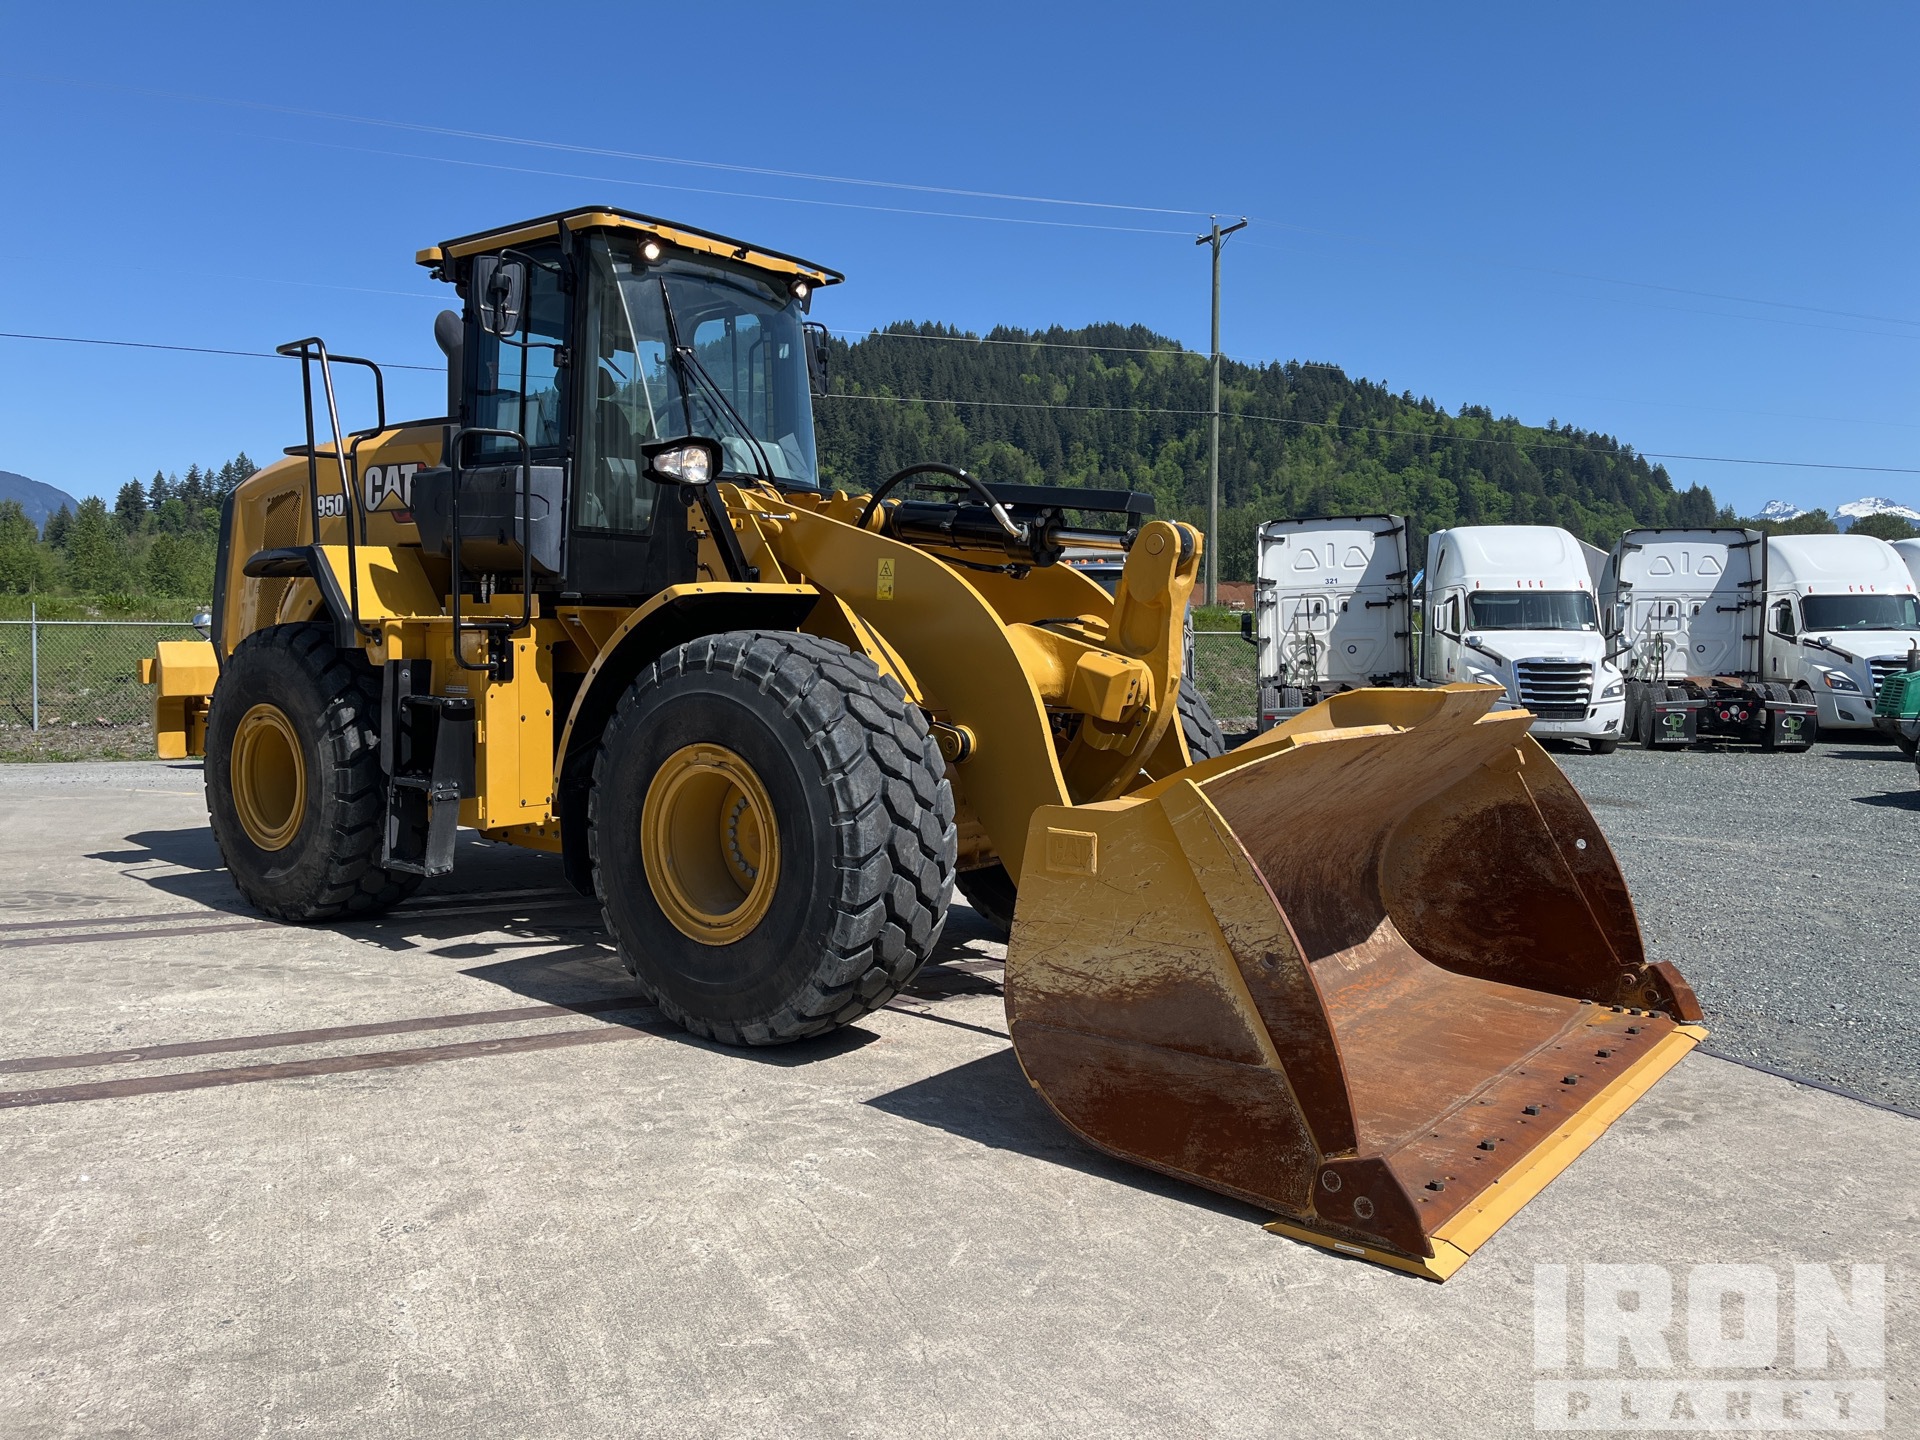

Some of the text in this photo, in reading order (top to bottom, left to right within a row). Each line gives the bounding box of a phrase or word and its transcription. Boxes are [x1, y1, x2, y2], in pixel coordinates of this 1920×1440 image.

[364, 463, 418, 512] CAT
[317, 494, 344, 517] 950
[1049, 835, 1092, 868] CAT
